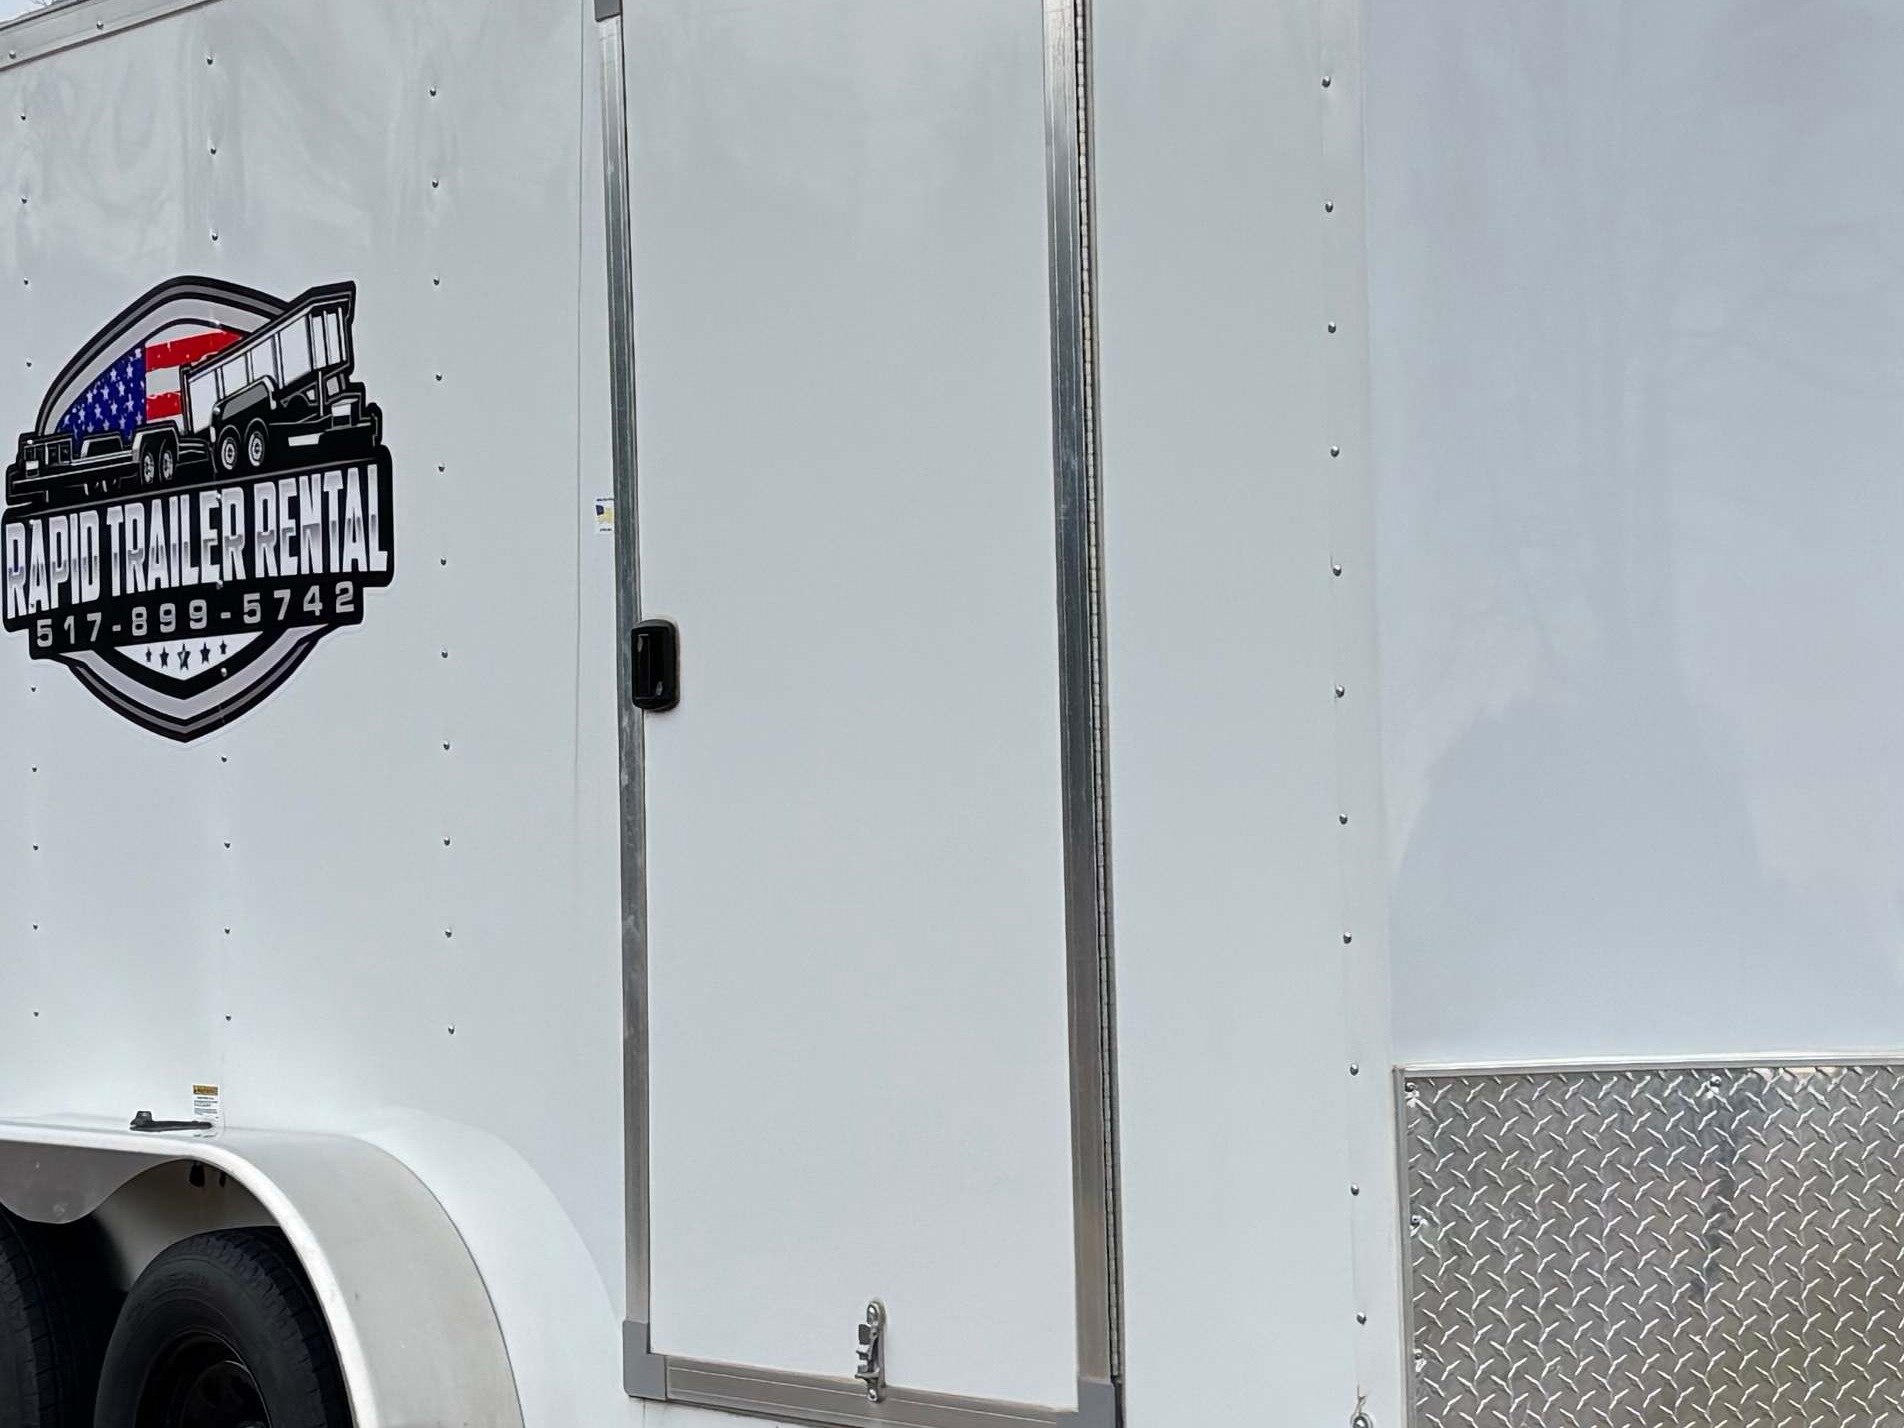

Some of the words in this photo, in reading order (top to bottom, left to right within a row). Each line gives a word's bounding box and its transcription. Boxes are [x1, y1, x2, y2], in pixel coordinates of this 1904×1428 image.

[5, 510, 100, 619] RAPID
[106, 487, 247, 597] TRAILER
[253, 464, 388, 579] RENTAL
[36, 581, 355, 648] 517-899-5742
